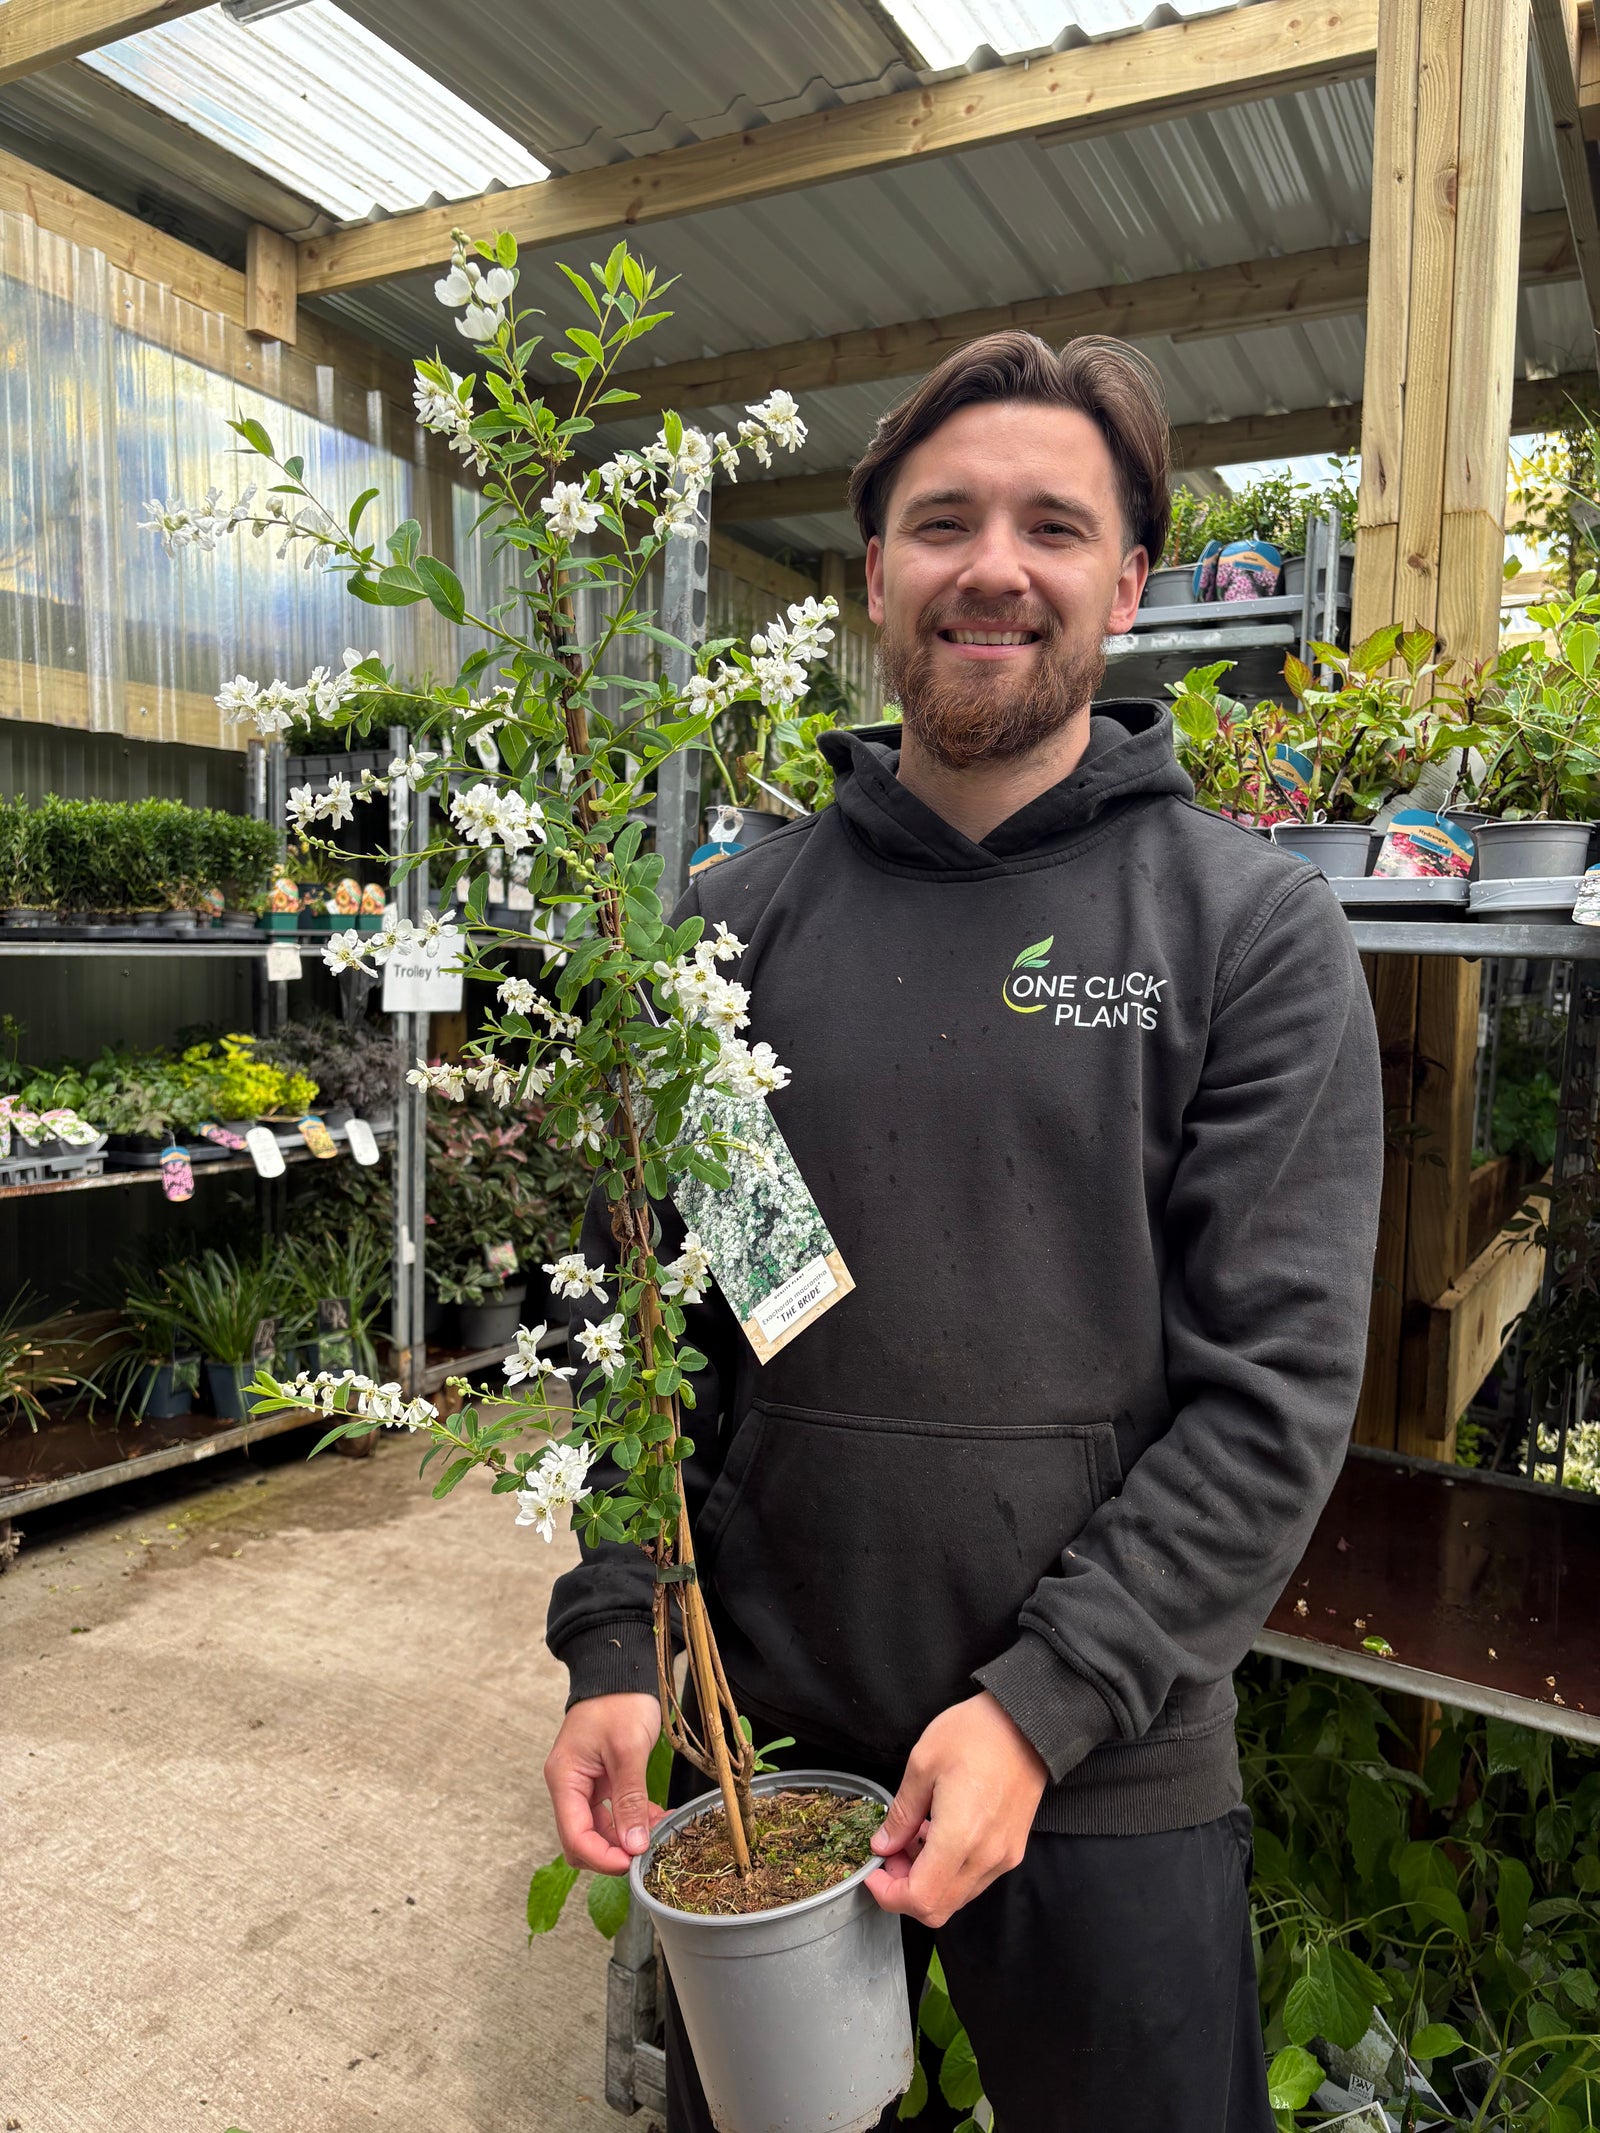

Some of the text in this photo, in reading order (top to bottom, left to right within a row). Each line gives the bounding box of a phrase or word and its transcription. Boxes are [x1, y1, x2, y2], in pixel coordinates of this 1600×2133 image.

[1418, 828, 1449, 845] Hydrangea
[393, 964, 432, 981] Trolley
[1012, 972, 1168, 1002] ONE CLICK
[1055, 1002, 1158, 1030] PLANTS
